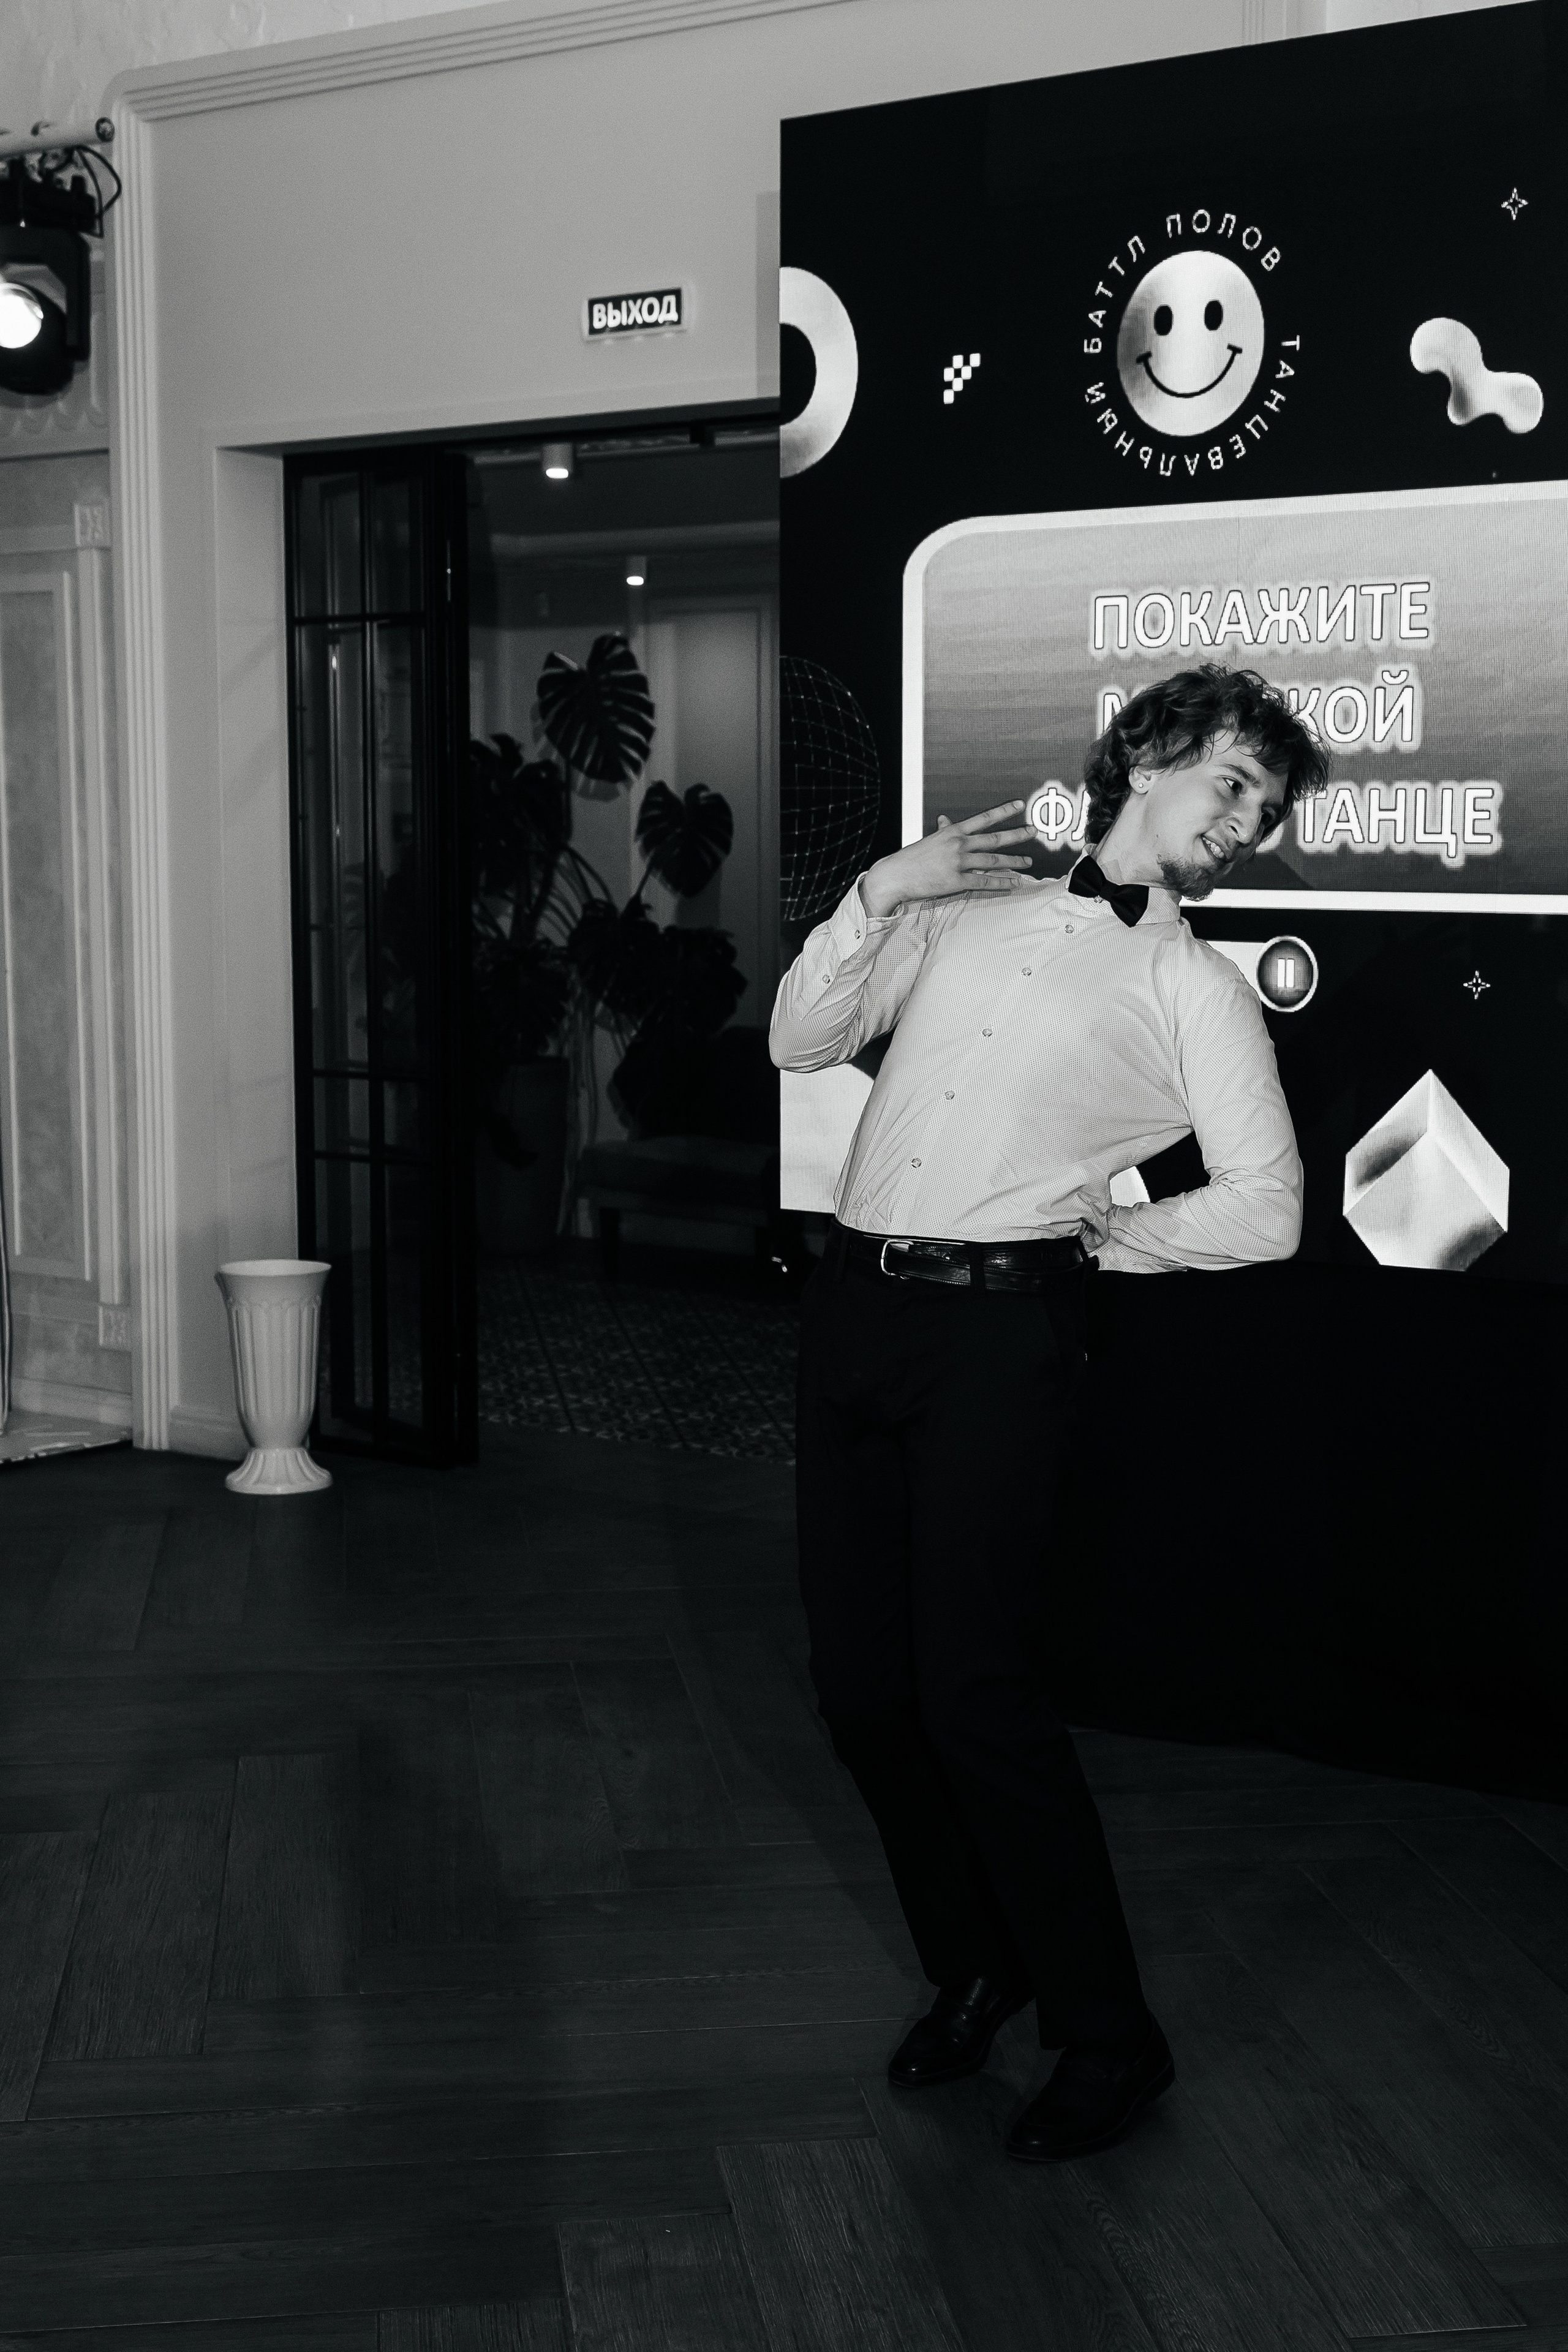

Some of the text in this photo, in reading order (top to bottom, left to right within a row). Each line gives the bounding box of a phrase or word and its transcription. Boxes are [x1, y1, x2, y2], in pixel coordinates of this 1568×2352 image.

[592, 295, 679, 330] ВЫХОД
[1084, 209, 1300, 477] ТАНЦЕВАЛЬНЫЙ БАТТЛ ПОЛОВ
[1093, 581, 1430, 649] ПОКАЖИТЕ
[1294, 788, 1494, 858] ТАНЦЕ
